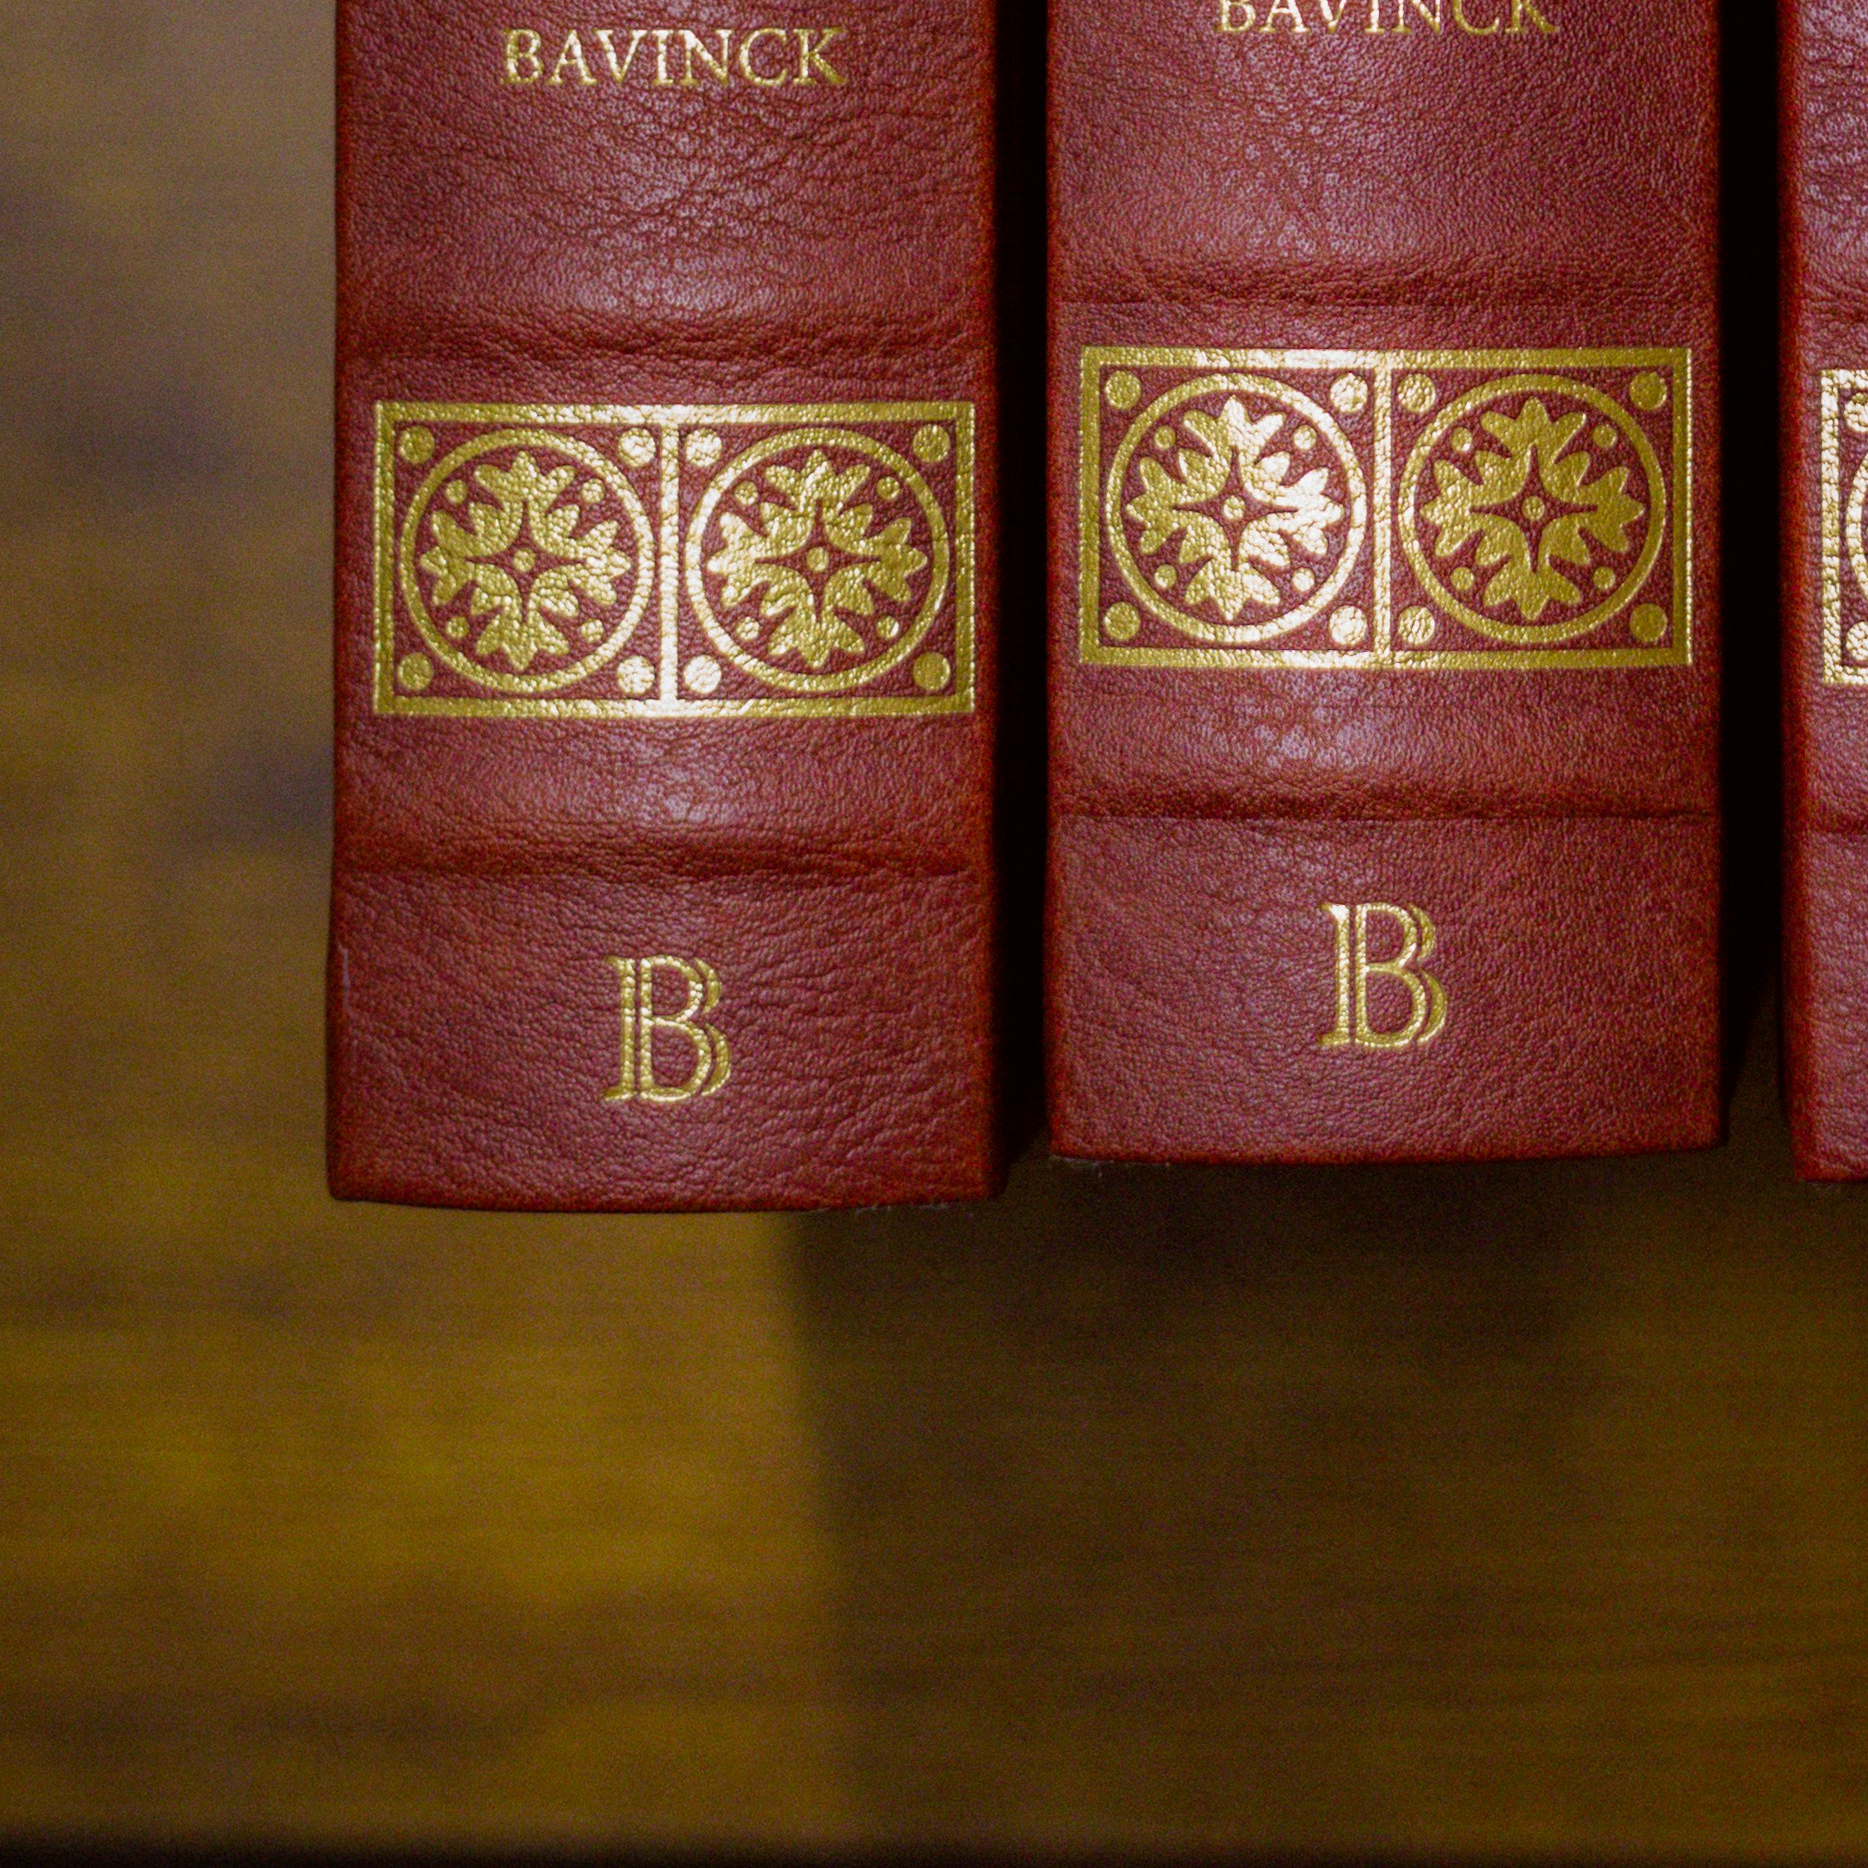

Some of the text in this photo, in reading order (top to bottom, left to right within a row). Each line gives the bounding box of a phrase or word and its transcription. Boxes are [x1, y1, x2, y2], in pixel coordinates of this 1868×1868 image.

[501, 27, 847, 90] BAVINCK
[604, 955, 730, 1105] B
[1320, 901, 1449, 1051] B
